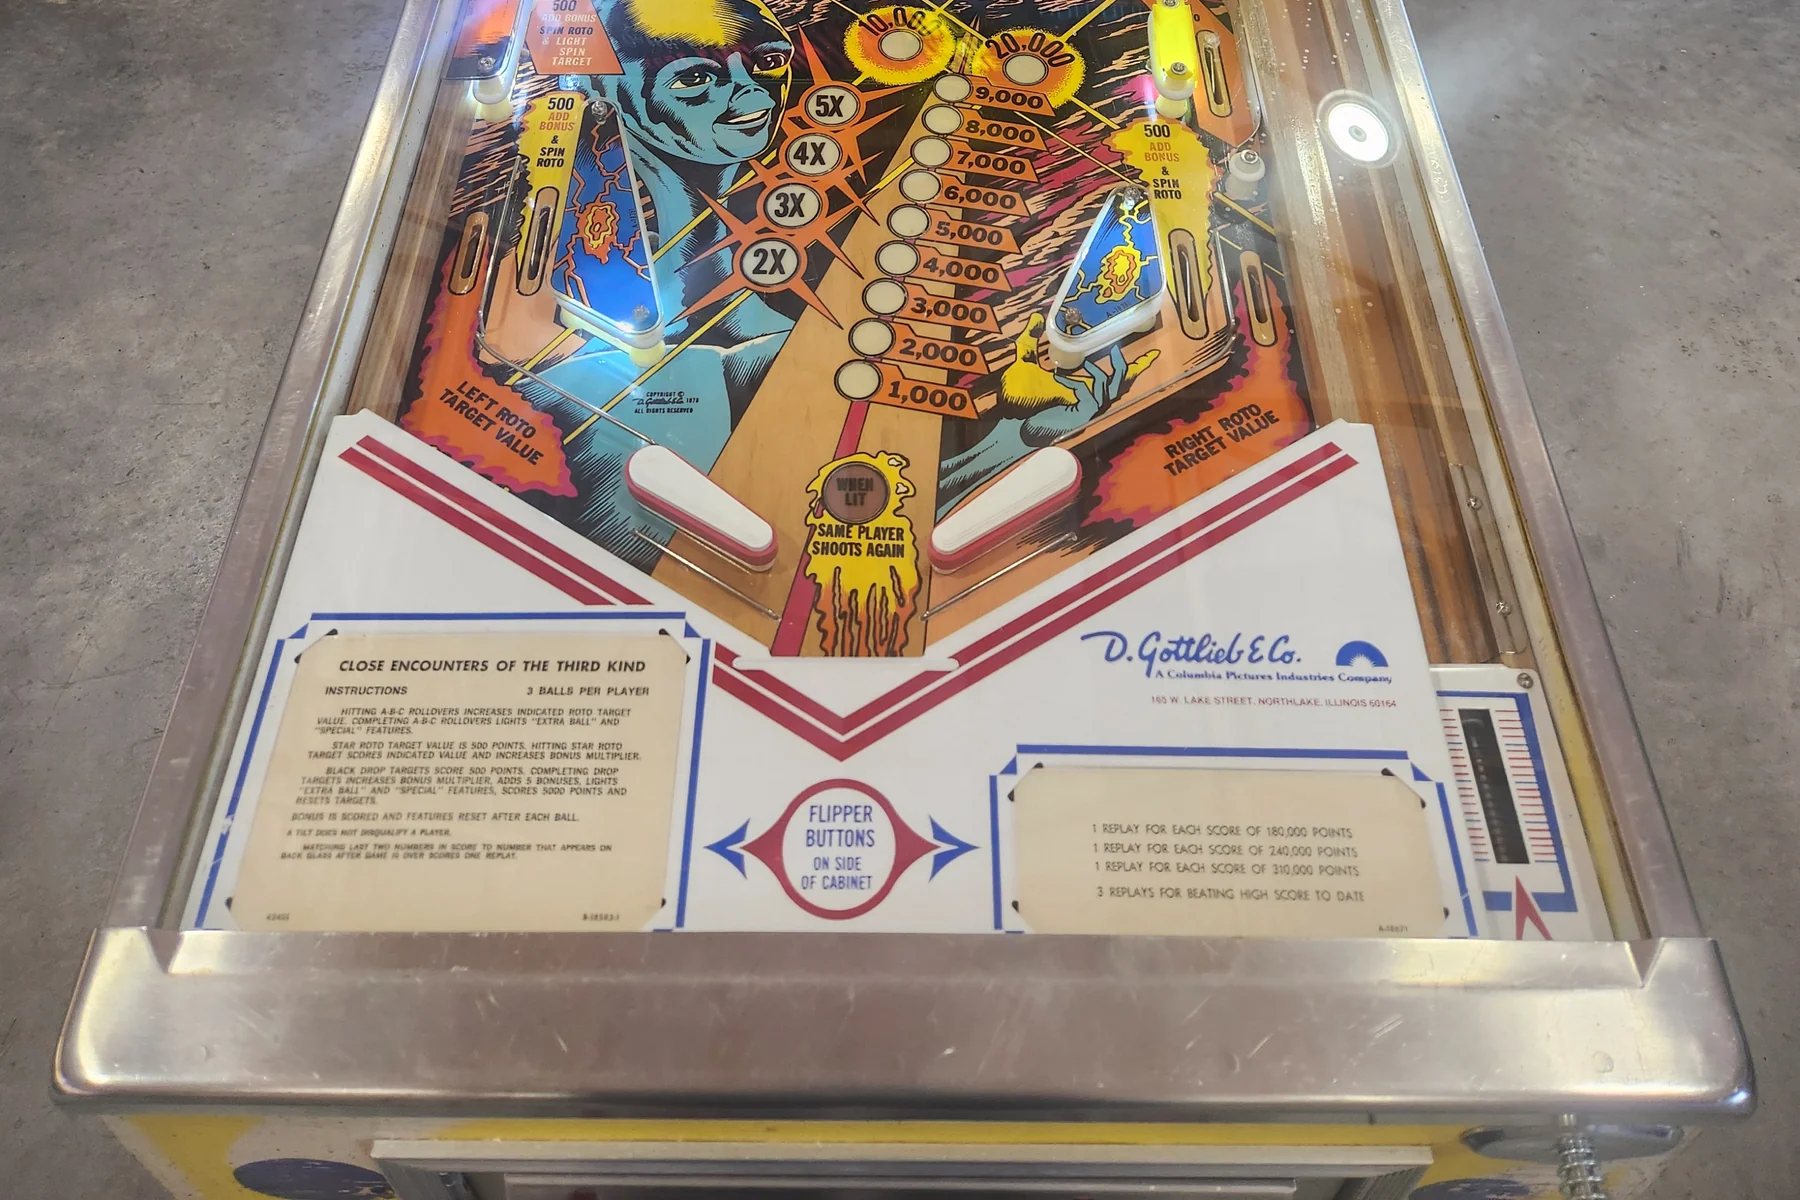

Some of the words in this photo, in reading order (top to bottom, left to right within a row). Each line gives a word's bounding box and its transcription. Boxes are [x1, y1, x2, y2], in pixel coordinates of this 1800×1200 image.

[552, 0, 577, 12] 500
[541, 13, 561, 22] ADD
[564, 13, 597, 22] BONUS
[539, 26, 564, 35] SPIN
[567, 26, 594, 35] ROTO
[556, 37, 588, 45] LIGHT
[559, 47, 586, 56] SPIN
[985, 32, 1075, 68] 20,000
[551, 57, 592, 66] TARGET
[547, 97, 575, 110] 500
[975, 86, 1044, 109] 9,000
[815, 94, 845, 118] 5X
[548, 112, 570, 121] ADD
[539, 121, 575, 131] BONUS
[964, 119, 1036, 143] 8,000
[1143, 123, 1171, 138] 500
[551, 135, 559, 144] &
[1149, 141, 1172, 151] ADD
[539, 147, 565, 157] SPIN
[792, 142, 827, 166] 4X
[1144, 152, 1180, 163] BONUS
[536, 158, 564, 168] ROTO
[956, 150, 1026, 175] 7,000
[1161, 166, 1170, 176] &
[1152, 178, 1181, 189] SPIN
[944, 185, 1017, 209] 6,000
[1153, 188, 1182, 200] ROTO
[774, 192, 806, 217] 3X
[934, 221, 1003, 246] 5,000
[752, 248, 786, 276] 2X
[922, 257, 999, 284] 4,000
[910, 296, 987, 322] 3,000
[899, 337, 977, 367] 2,000
[888, 379, 967, 411] 1,000
[456, 381, 498, 410] LEFT
[498, 406, 537, 438] ROTO
[439, 388, 497, 433] TARGET
[495, 430, 544, 466] VALUE
[1163, 426, 1215, 459] RIGHT
[1217, 403, 1263, 432] ROTO
[1163, 440, 1227, 477] TARGET
[1226, 410, 1280, 443] VALUE
[836, 477, 873, 492] WHEN
[844, 493, 865, 507] LIT
[817, 523, 853, 538] SAME
[857, 527, 904, 542] PLAYER
[812, 541, 862, 557] SHOOTS
[866, 543, 905, 558] AGAIN
[1081, 631, 1133, 663] D.
[1138, 630, 1245, 678] Gottlieb
[1268, 634, 1302, 664] Co.
[339, 660, 385, 672] CLOSE
[390, 660, 489, 672] ENCOUNTERS
[496, 660, 517, 672] OF
[523, 660, 550, 672] THE
[556, 660, 600, 672] THIRD
[607, 660, 646, 673] KIND
[1155, 669, 1165, 679] A
[1168, 669, 1223, 680] Columbia
[1225, 670, 1273, 681] Pictures
[1275, 671, 1335, 682] Industries
[1337, 673, 1393, 685] Company
[325, 686, 408, 696] INSTRUCTIONS
[526, 686, 533, 696] 3
[538, 686, 574, 696] BALLS
[579, 686, 601, 696] PER
[606, 686, 650, 696] PLAYER
[1151, 695, 1167, 704] 165
[1183, 696, 1212, 705] LAKE
[1324, 698, 1367, 707] ILLINOIS
[1368, 698, 1397, 708] 60164
[809, 804, 873, 823] FLIPPER
[805, 829, 875, 848] BUTTONS
[813, 856, 830, 871] ON
[834, 856, 862, 871] SIDE
[801, 875, 817, 890] OF
[822, 875, 873, 890] CABINET
[1097, 886, 1104, 897] 3
[1109, 887, 1154, 898] REPLAYS
[1160, 887, 1182, 898] FOR
[1187, 888, 1235, 899] BEATING
[1240, 889, 1268, 900] HIGH
[1274, 889, 1310, 901] SCORE
[1316, 890, 1331, 901] TO
[1337, 890, 1365, 902] DATE
